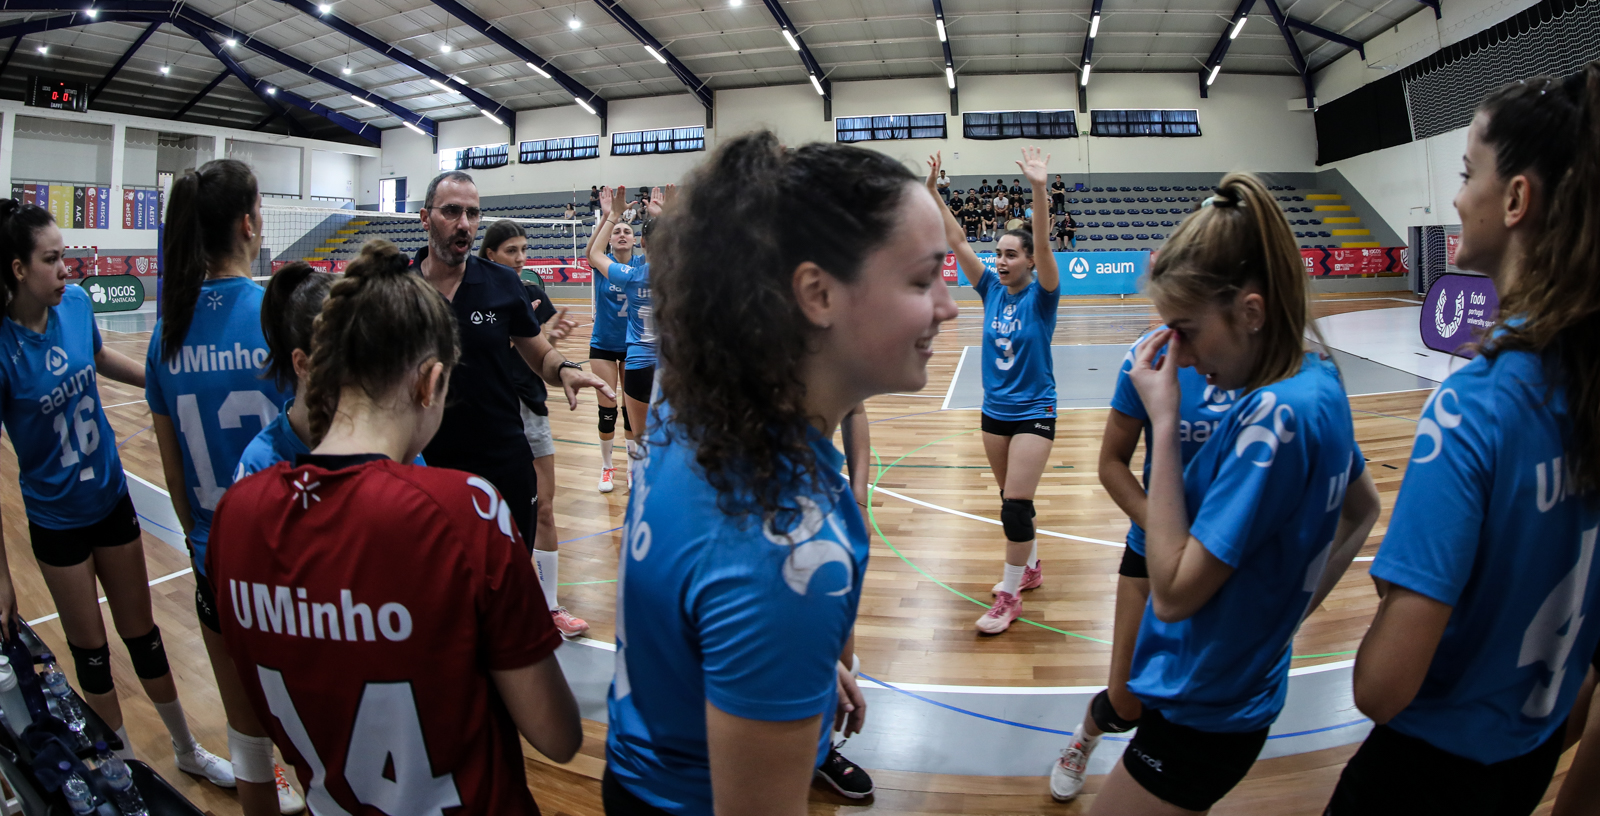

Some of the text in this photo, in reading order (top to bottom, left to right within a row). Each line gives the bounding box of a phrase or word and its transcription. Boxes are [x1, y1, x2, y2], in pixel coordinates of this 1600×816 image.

[1095, 261, 1135, 275] aaum
[108, 285, 136, 301] JOGOS
[1470, 291, 1486, 305] fadu
[1468, 308, 1484, 318] portugal
[168, 342, 270, 375] UMinho
[994, 337, 1016, 371] 3
[39, 364, 95, 414] aaum
[53, 395, 100, 468] 16
[229, 578, 413, 642] UMinho
[256, 664, 463, 816] 14
